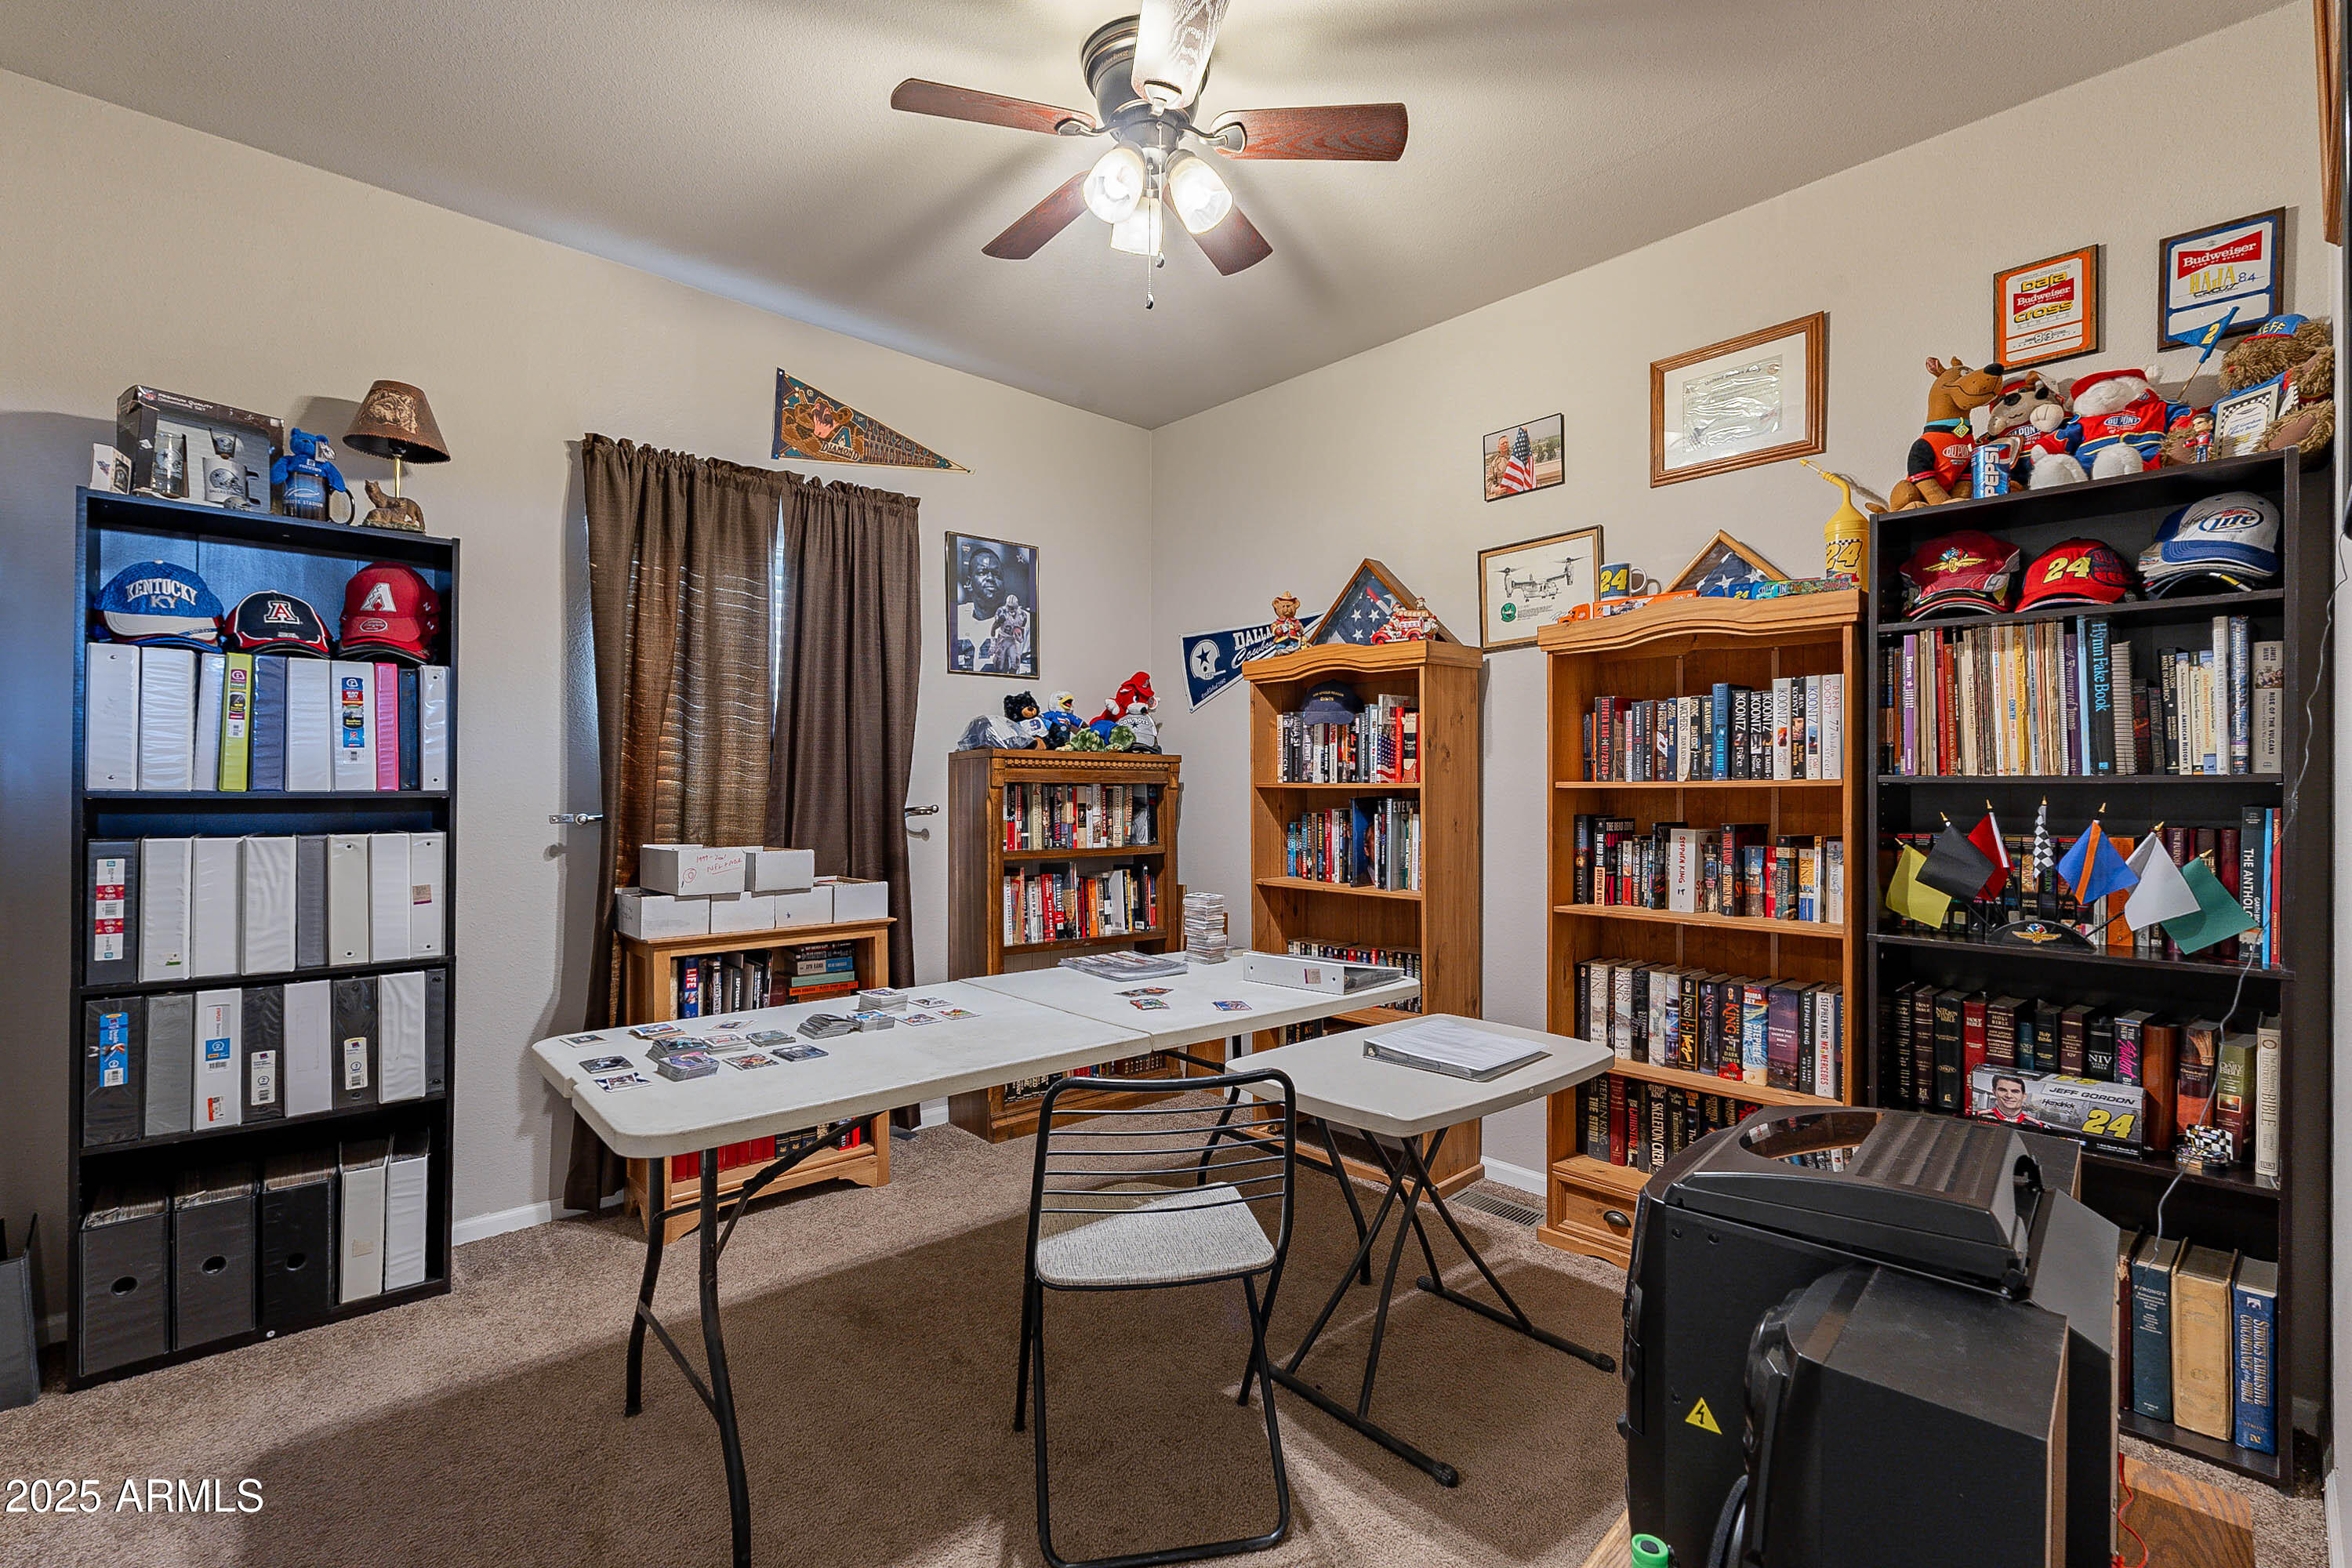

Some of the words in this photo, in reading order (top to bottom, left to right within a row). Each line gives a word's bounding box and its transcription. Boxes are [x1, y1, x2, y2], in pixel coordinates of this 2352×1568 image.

[2183, 243, 2256, 267] Budweiser
[2017, 286, 2071, 306] Budweiser
[821, 441, 859, 462] DIAMOND
[864, 417, 936, 460] ARIZONA
[863, 440, 938, 466] DIAMONDBACKS
[1984, 447, 1999, 498] PEPSI
[2209, 514, 2256, 531] Lite
[1827, 541, 1863, 571] 24
[1600, 568, 1628, 592] 24
[2043, 557, 2092, 585] 24
[125, 577, 198, 606] KENTUCKY
[150, 595, 179, 609] KY
[1733, 590, 1749, 599] 24
[264, 601, 301, 624] A
[1232, 626, 1275, 650] DALLA
[2089, 623, 2108, 655] Hymn
[1231, 640, 1272, 669] Cowbo
[2093, 658, 2110, 682] Fake
[1777, 690, 1788, 725] KOONTZ
[1808, 688, 1818, 724] KOONTZ
[2095, 684, 2111, 712] Book
[1120, 717, 1149, 726] COWBOYS
[1679, 702, 1688, 731] WATCHERS
[1735, 695, 1746, 731] KOONTZ
[1751, 697, 1761, 733] KOONTZ
[1762, 695, 1772, 731] KOONTZ
[1829, 720, 1838, 732] 77
[1723, 850, 1733, 864] LANDS
[2243, 848, 2254, 868] THE
[1723, 875, 1732, 893] STEPHEN
[2243, 870, 2254, 918] ANTHOLO
[1723, 895, 1732, 906] KING
[687, 968, 697, 988] LIFE
[1704, 994, 1713, 1017] KING
[1744, 991, 1762, 1000] DUMA
[1722, 1003, 1739, 1034] KING
[1753, 1025, 1762, 1057] STEPHEN
[2089, 1054, 2112, 1064] NIV
[2118, 1039, 2137, 1079] Student
[1589, 1097, 1599, 1112] THE
[2041, 1098, 2076, 1109] Hendrick
[2049, 1087, 2078, 1095] JEFF
[2081, 1091, 2136, 1105] GORDON
[1652, 1102, 1664, 1141] SKELETON
[2261, 1094, 2277, 1127] BIBLE
[1589, 1116, 1599, 1143] STAND
[2082, 1109, 2136, 1139] 24
[1652, 1142, 1664, 1167] CREW
[2241, 1314, 2253, 1369] CONCORDANCE
[2253, 1319, 2269, 1356] STRONG'S
[2241, 1381, 2254, 1405] BIBLE
[2253, 1357, 2268, 1407] EXHAUSTIVE
